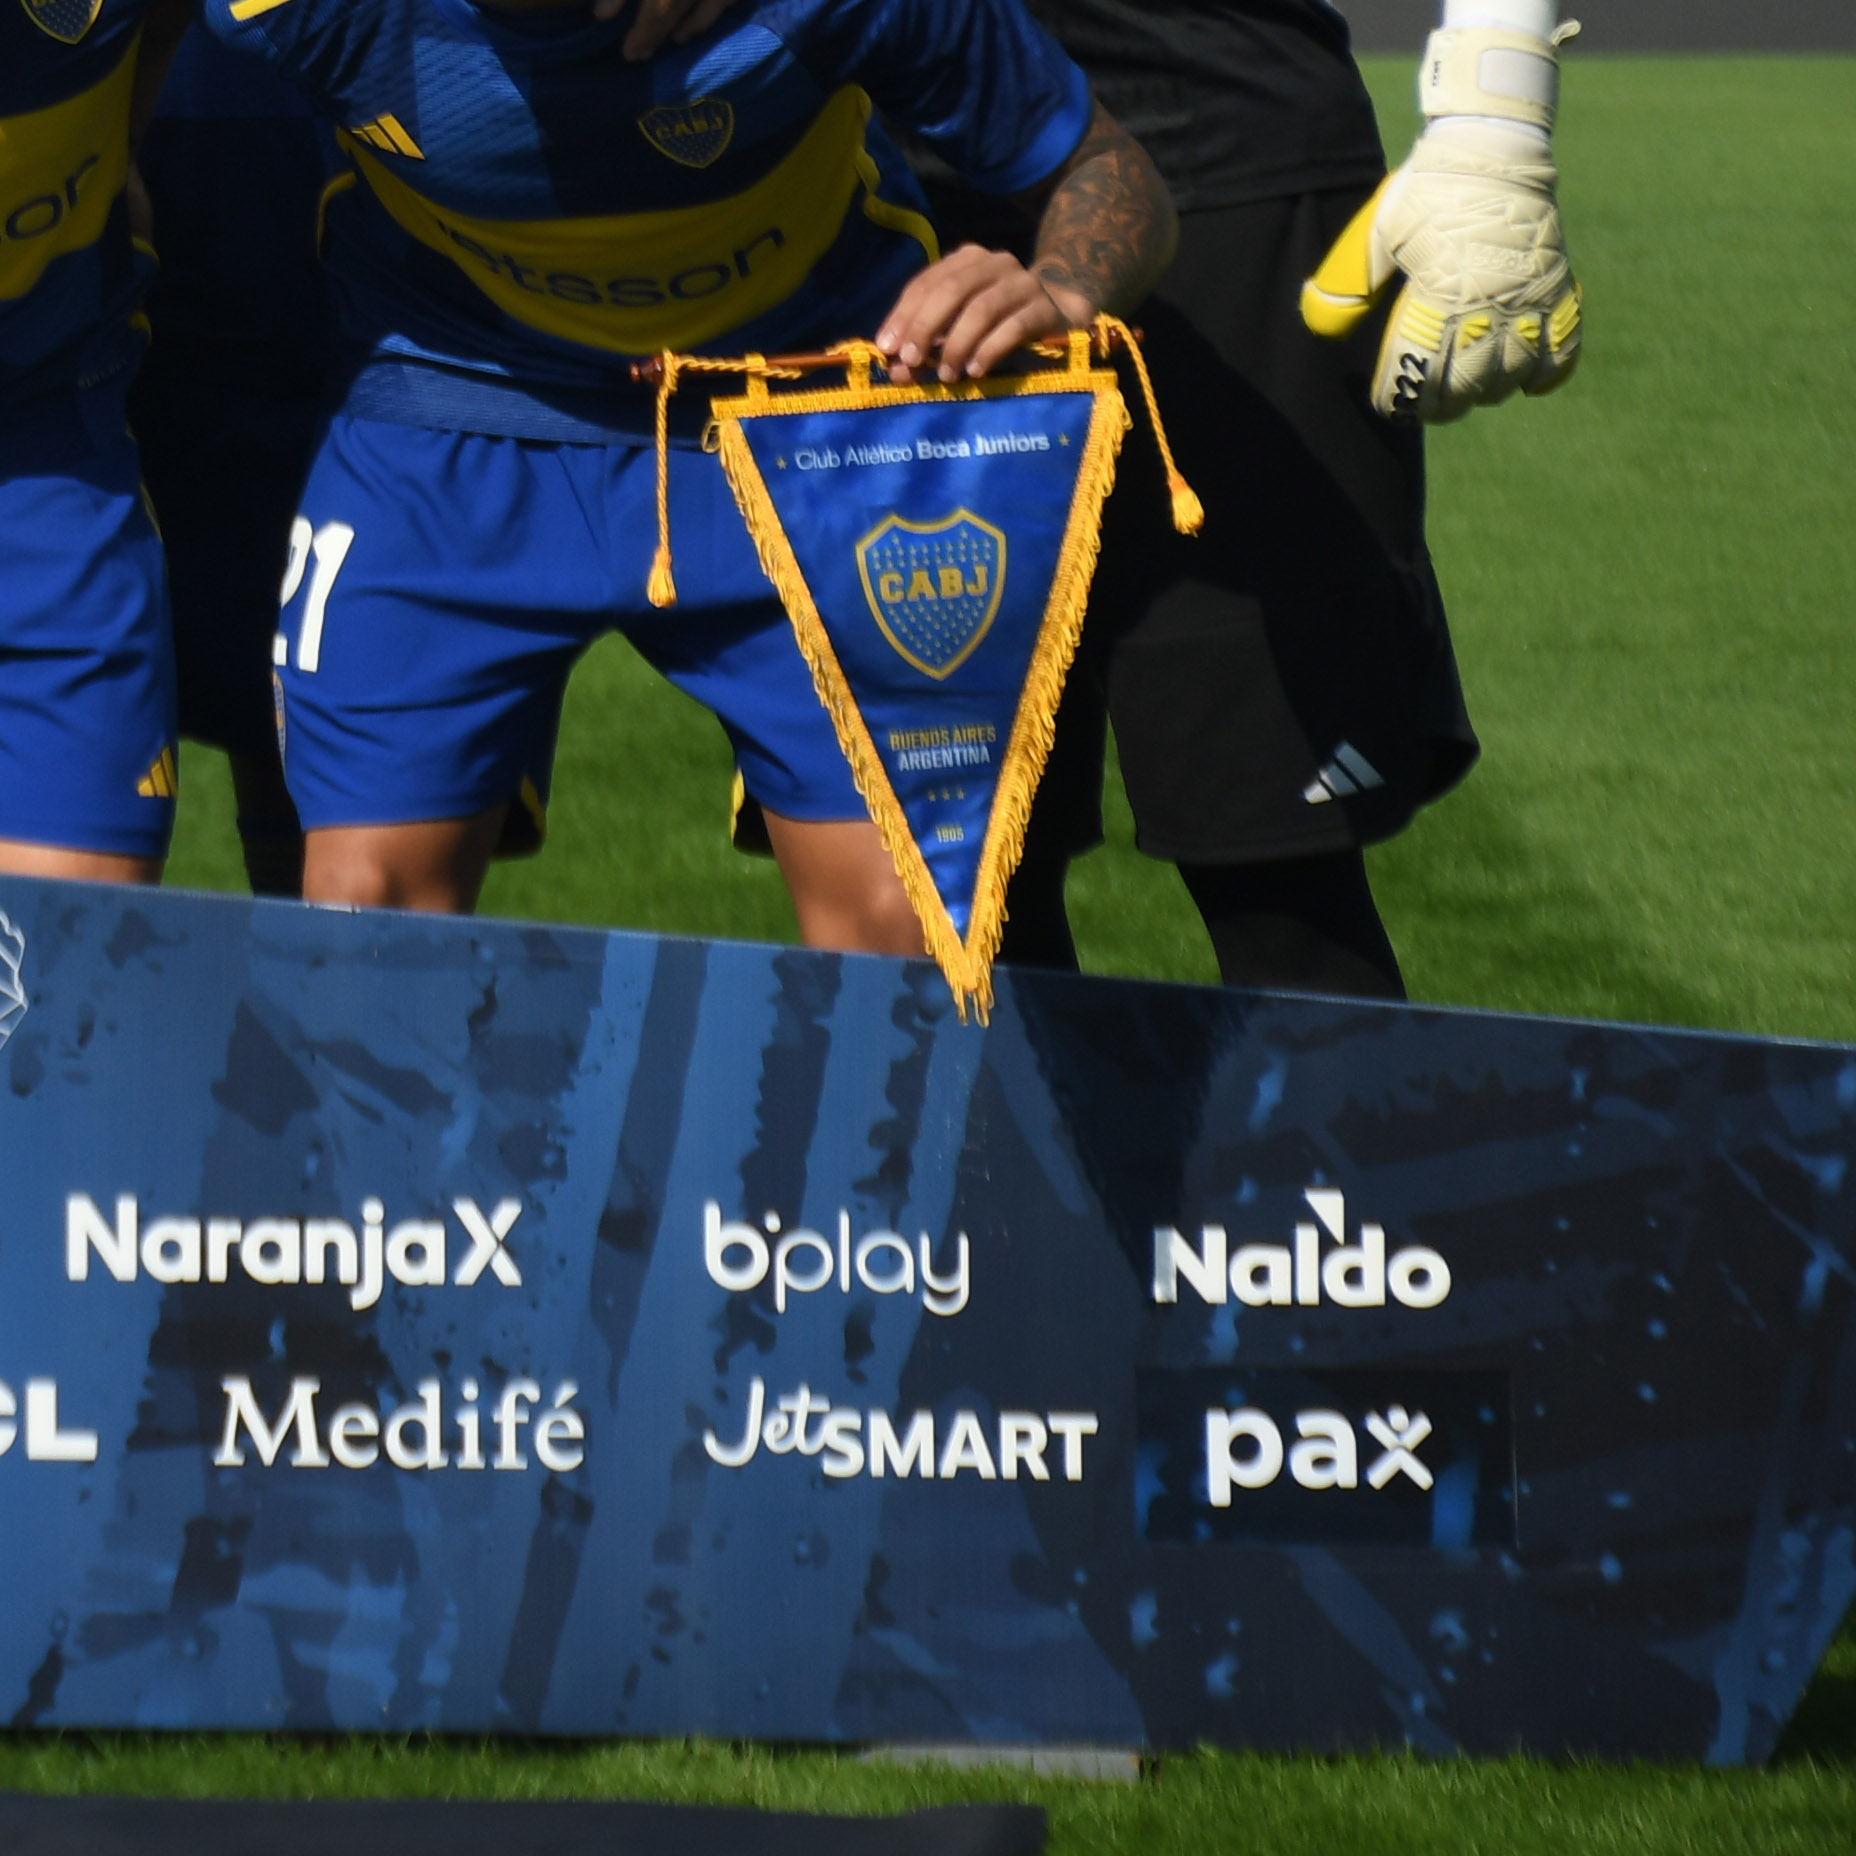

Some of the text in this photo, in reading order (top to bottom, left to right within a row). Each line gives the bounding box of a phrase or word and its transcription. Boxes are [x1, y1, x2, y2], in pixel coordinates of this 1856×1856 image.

[795, 447, 841, 471] Club
[916, 437, 971, 461] Boca
[975, 431, 1051, 457] Juniors
[878, 564, 989, 604] CABJ
[890, 728, 951, 752] BUENOS
[898, 746, 991, 772] ARGENTINA
[1153, 1223, 1452, 1309] Naldo
[212, 1372, 586, 1473] Medifé
[702, 1374, 1099, 1483] JetSMART
[1205, 1404, 1434, 1509] pax
